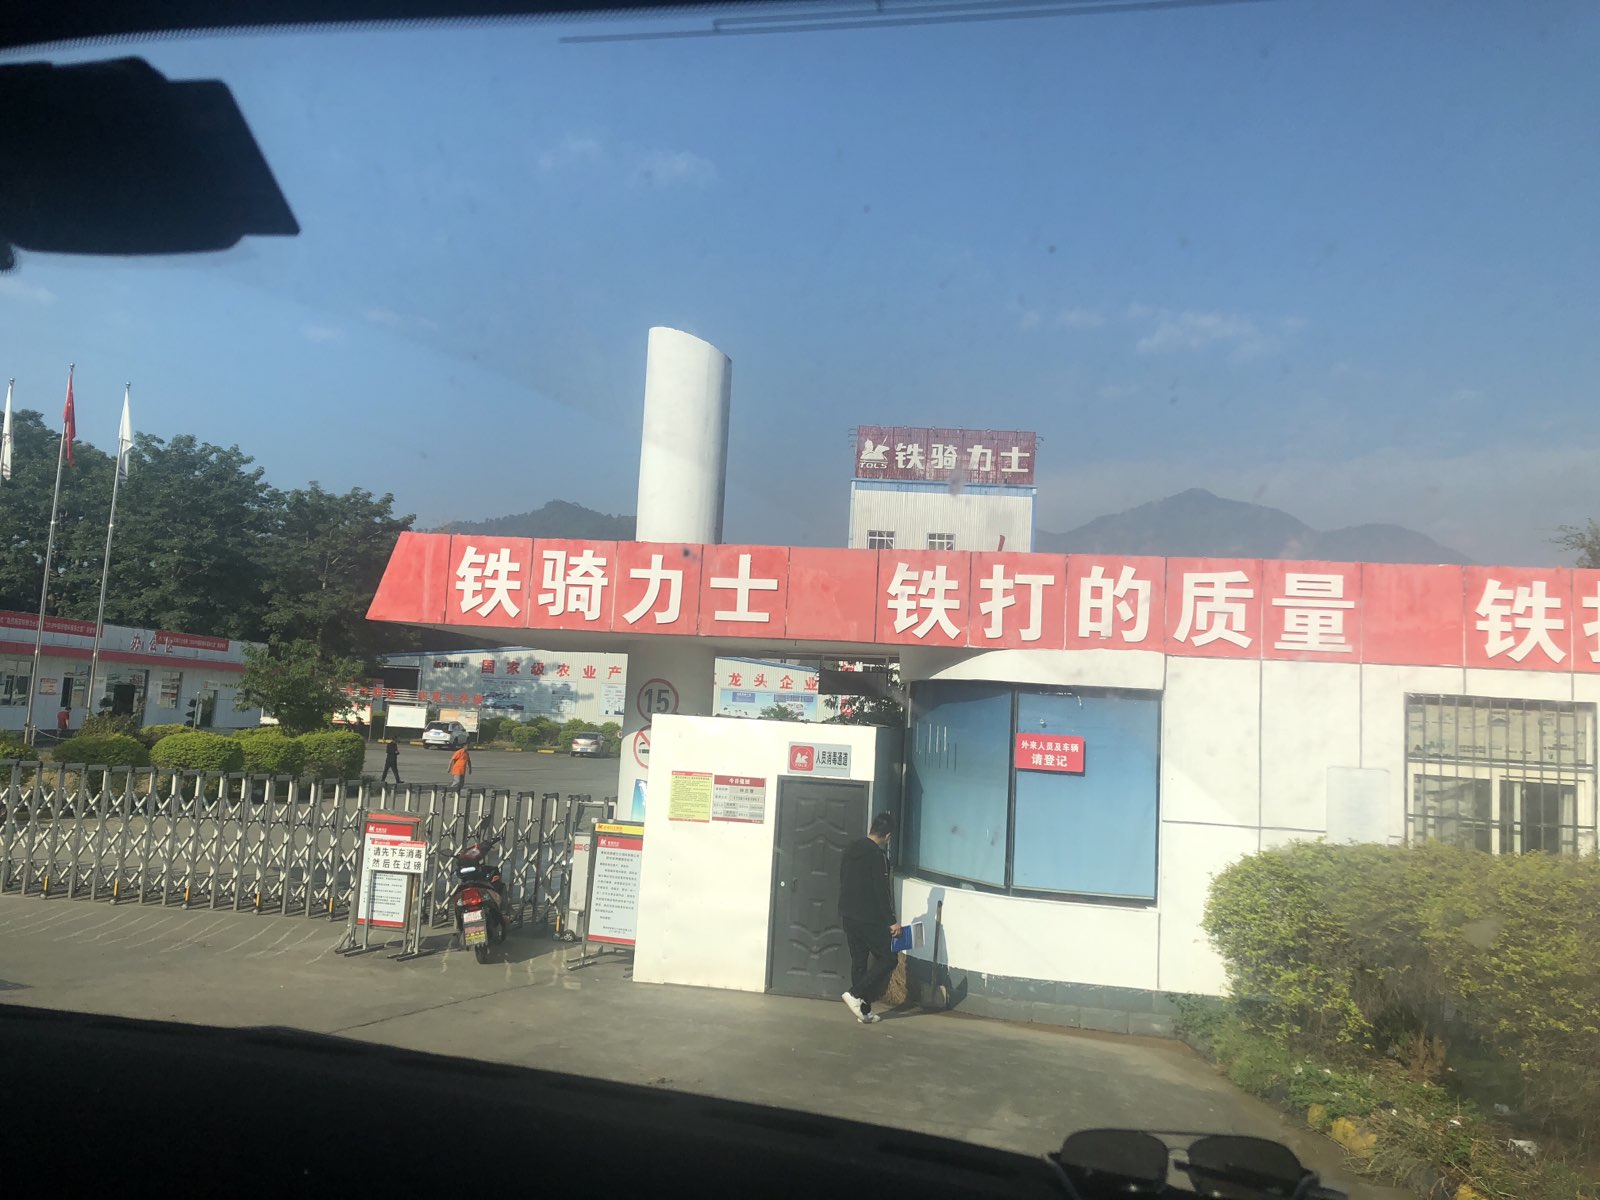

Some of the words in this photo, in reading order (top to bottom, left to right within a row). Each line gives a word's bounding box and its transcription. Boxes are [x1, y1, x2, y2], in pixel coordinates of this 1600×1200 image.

[895, 442, 1030, 473] 铁骑力士
[455, 545, 779, 624] 铁骑力士
[887, 562, 1355, 653] 铁打的质量
[481, 659, 622, 680] 国家级农业产
[728, 672, 818, 691] 龙头企业
[644, 688, 669, 713] 15
[1021, 740, 1079, 753] 外来人员及车辆
[816, 750, 848, 766] 人员消毒通道
[1031, 753, 1068, 767] 请登记
[373, 847, 422, 860] 请先下车消毒
[372, 858, 421, 871] 然后在过磅
